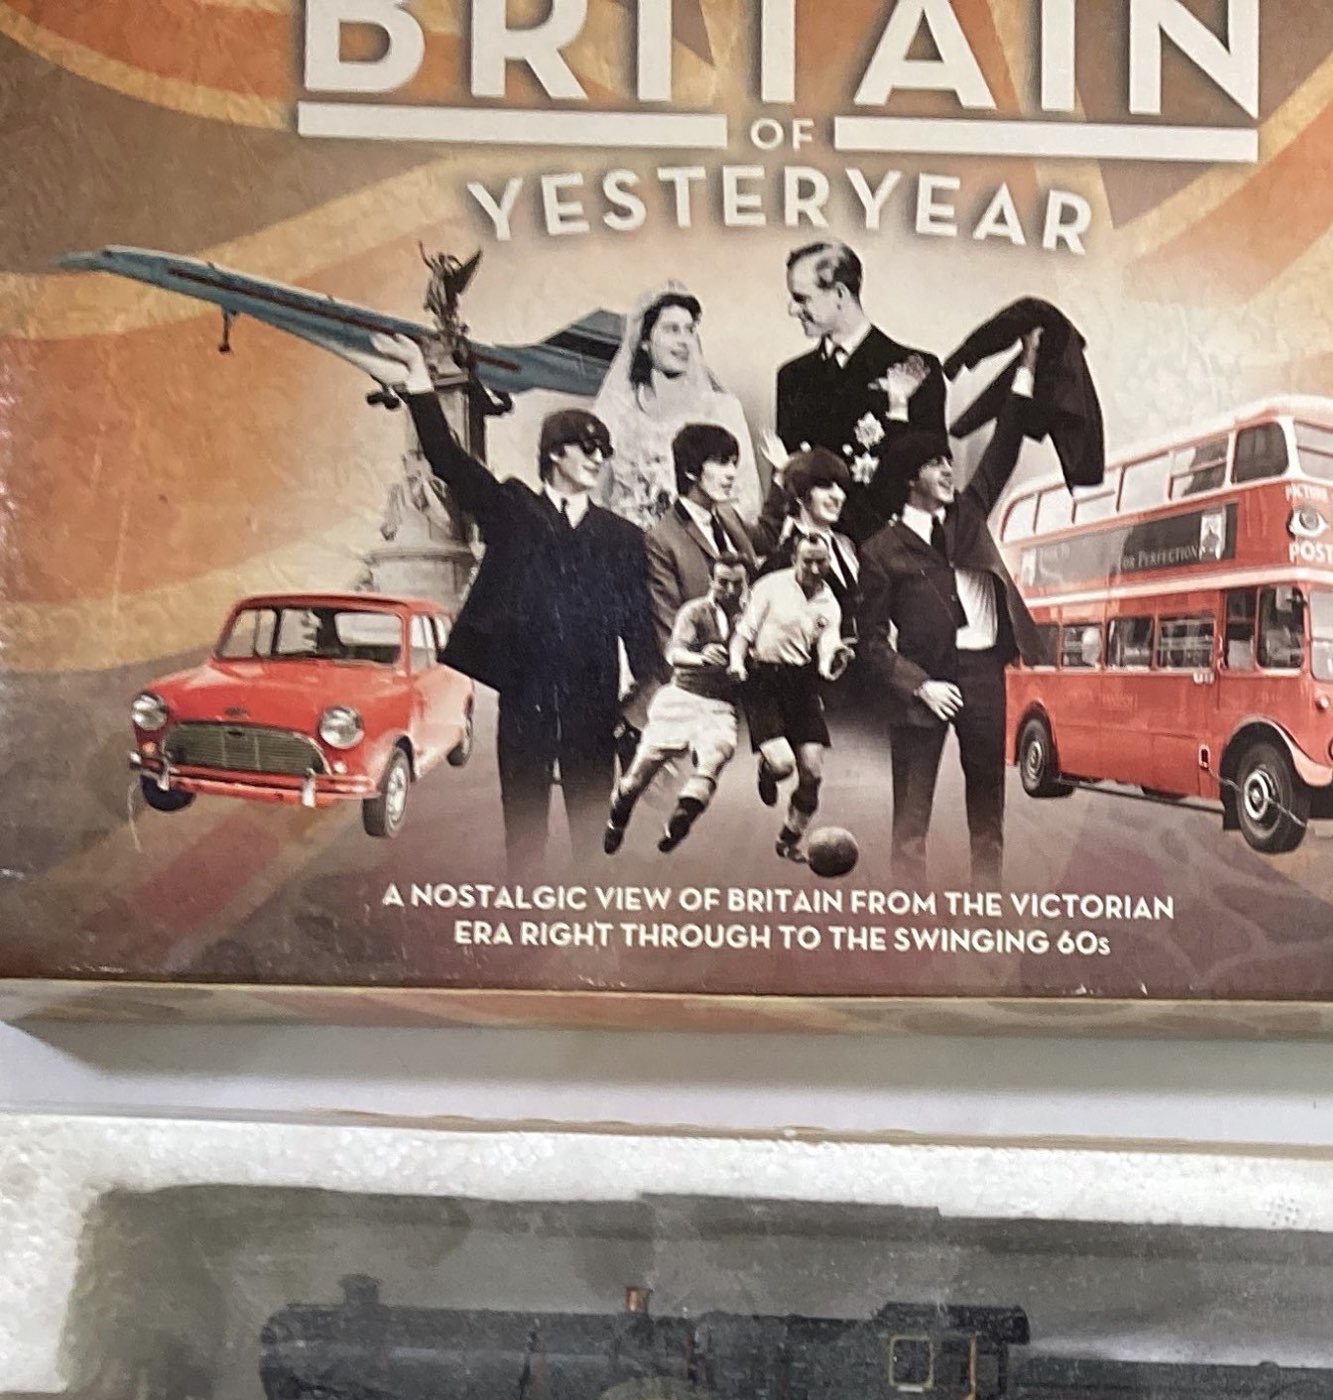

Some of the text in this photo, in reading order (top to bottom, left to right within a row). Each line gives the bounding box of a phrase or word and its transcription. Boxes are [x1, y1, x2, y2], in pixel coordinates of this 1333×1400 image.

[750, 117, 815, 151] OF
[466, 164, 1093, 256] YESTERYEAR
[382, 883, 1174, 920] A NOSTALGIC VIEW OF BRITAIN FROM THE VICTORIAN
[454, 920, 1111, 956] ERA RIGHT THROUGH TO THE SWINGING 60s
